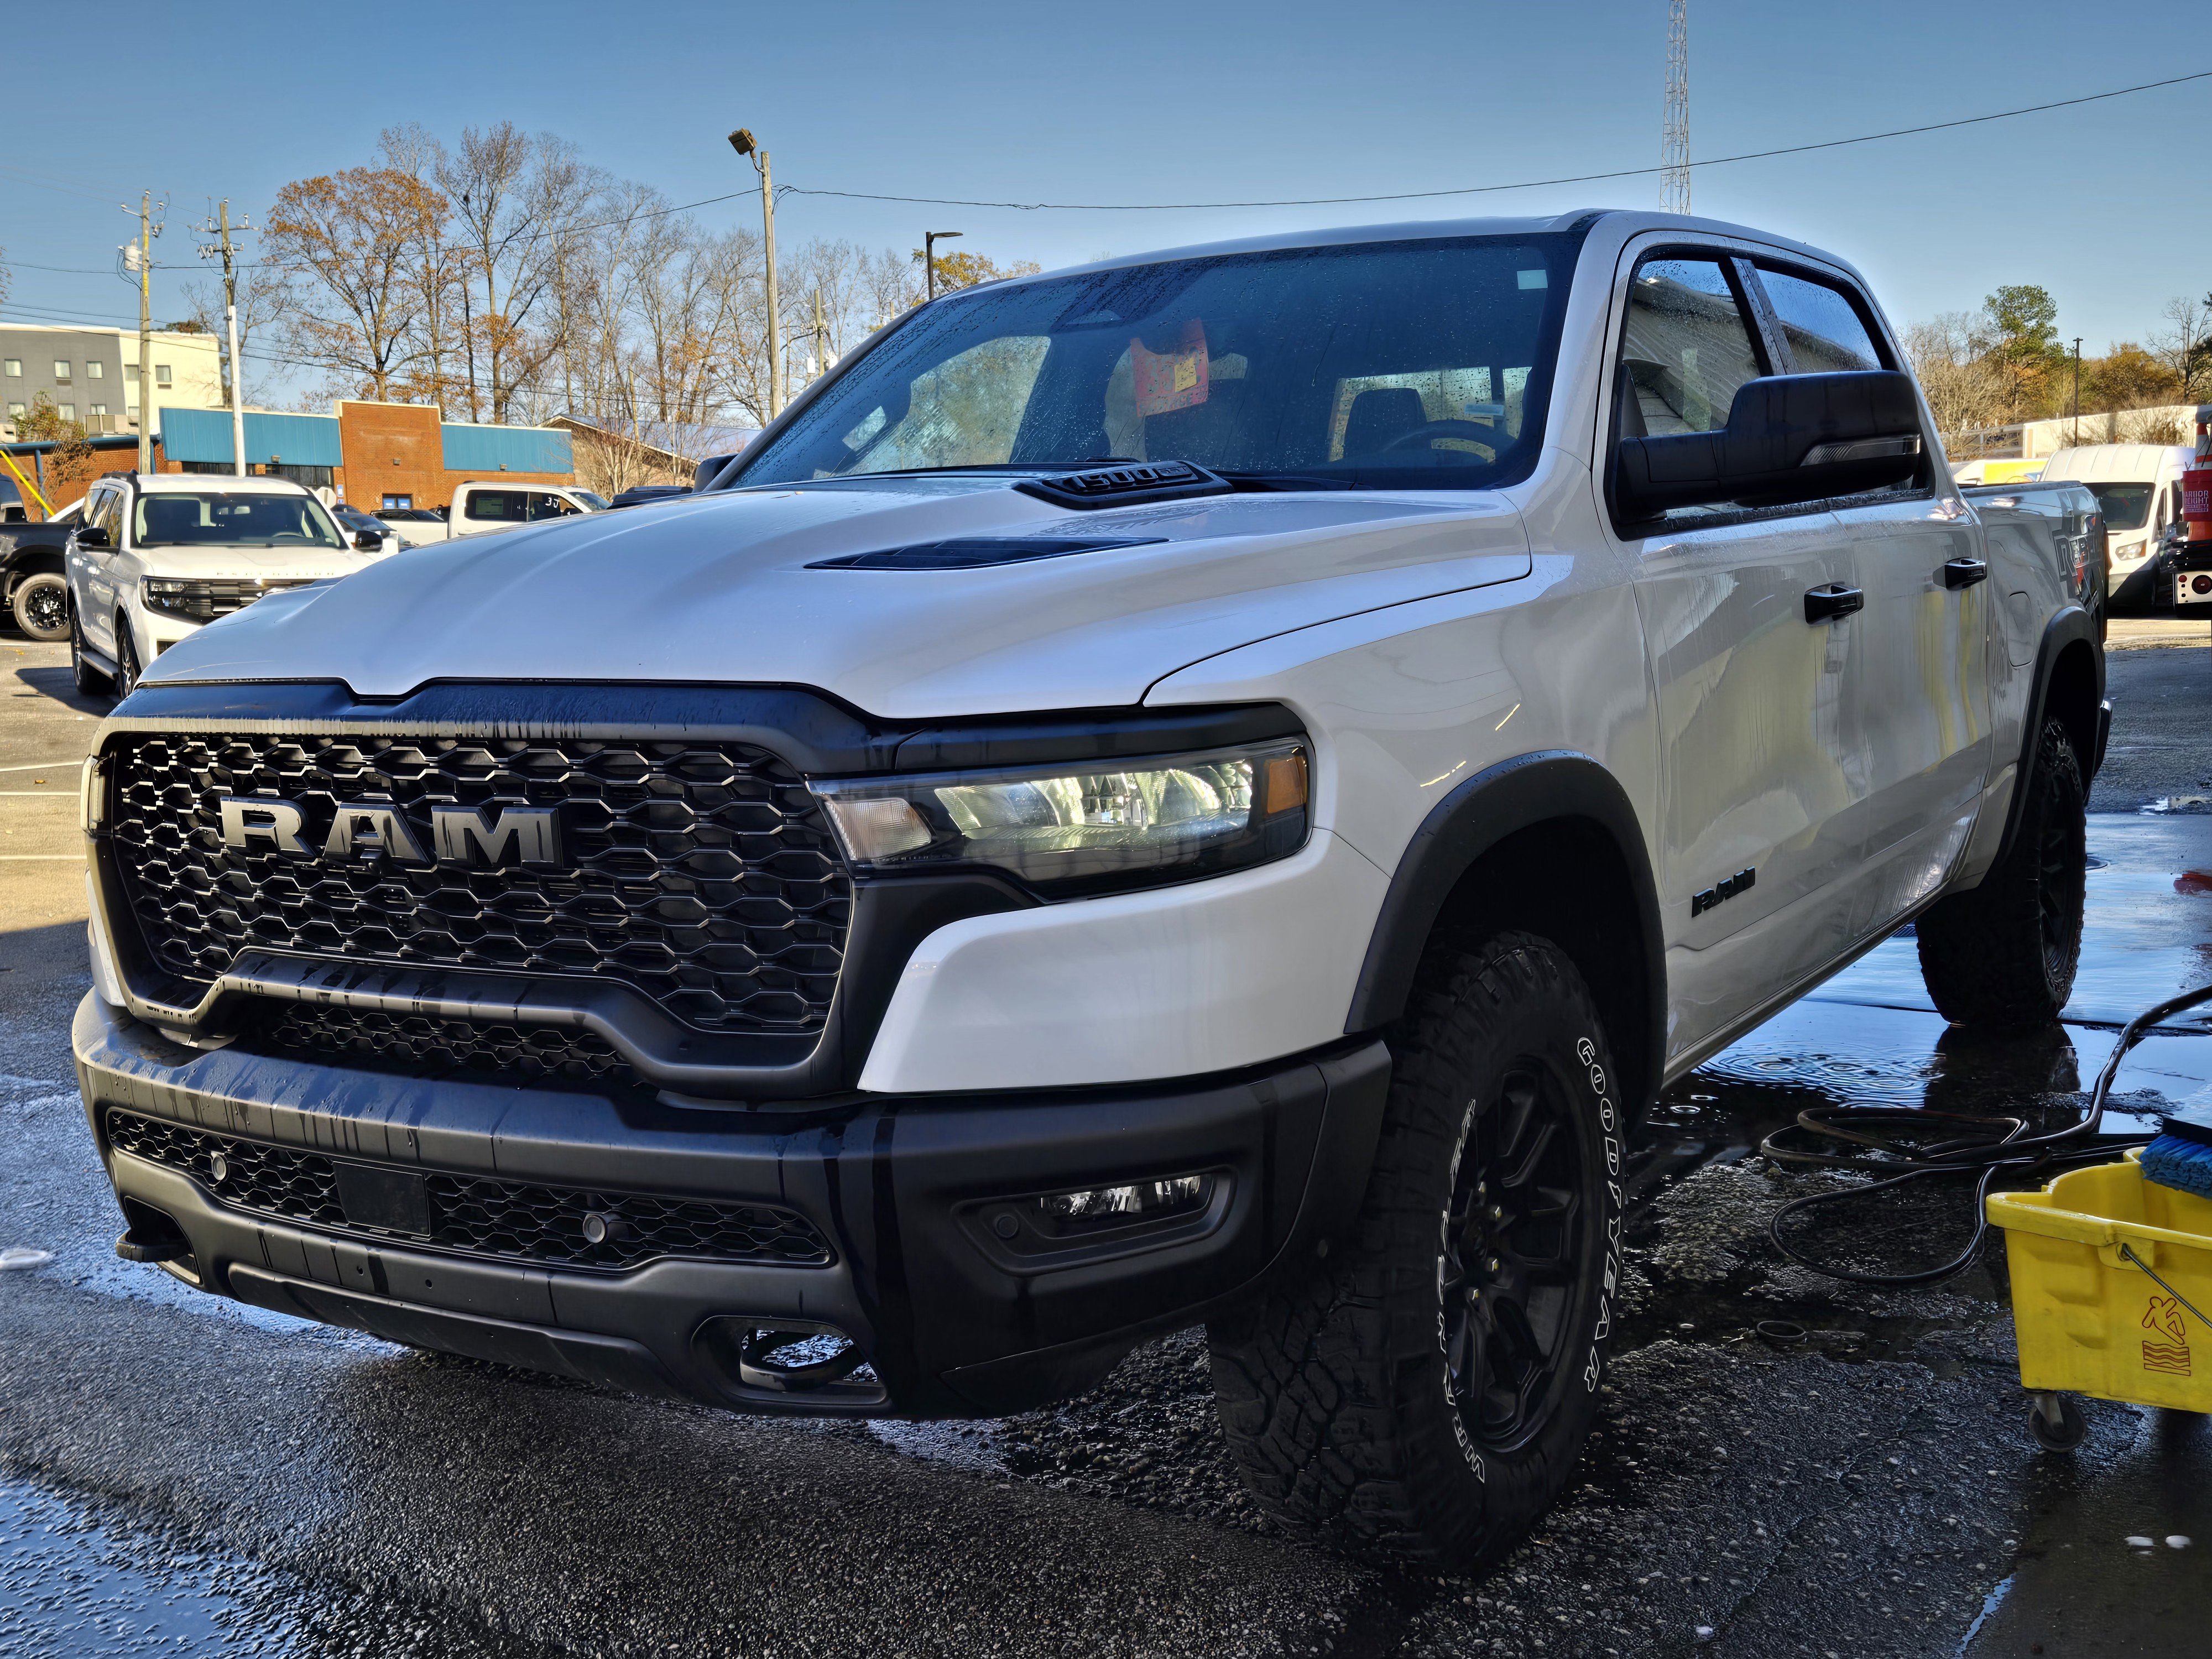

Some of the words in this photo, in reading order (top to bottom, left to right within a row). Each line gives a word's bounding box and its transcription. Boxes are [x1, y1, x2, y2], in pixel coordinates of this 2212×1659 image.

[1062, 468, 1158, 492] 1500
[2185, 490, 2209, 498] ARBOR
[221, 796, 563, 868] RAM
[1692, 866, 1755, 918] RAM
[1577, 1037, 1622, 1392] GOODYEAR
